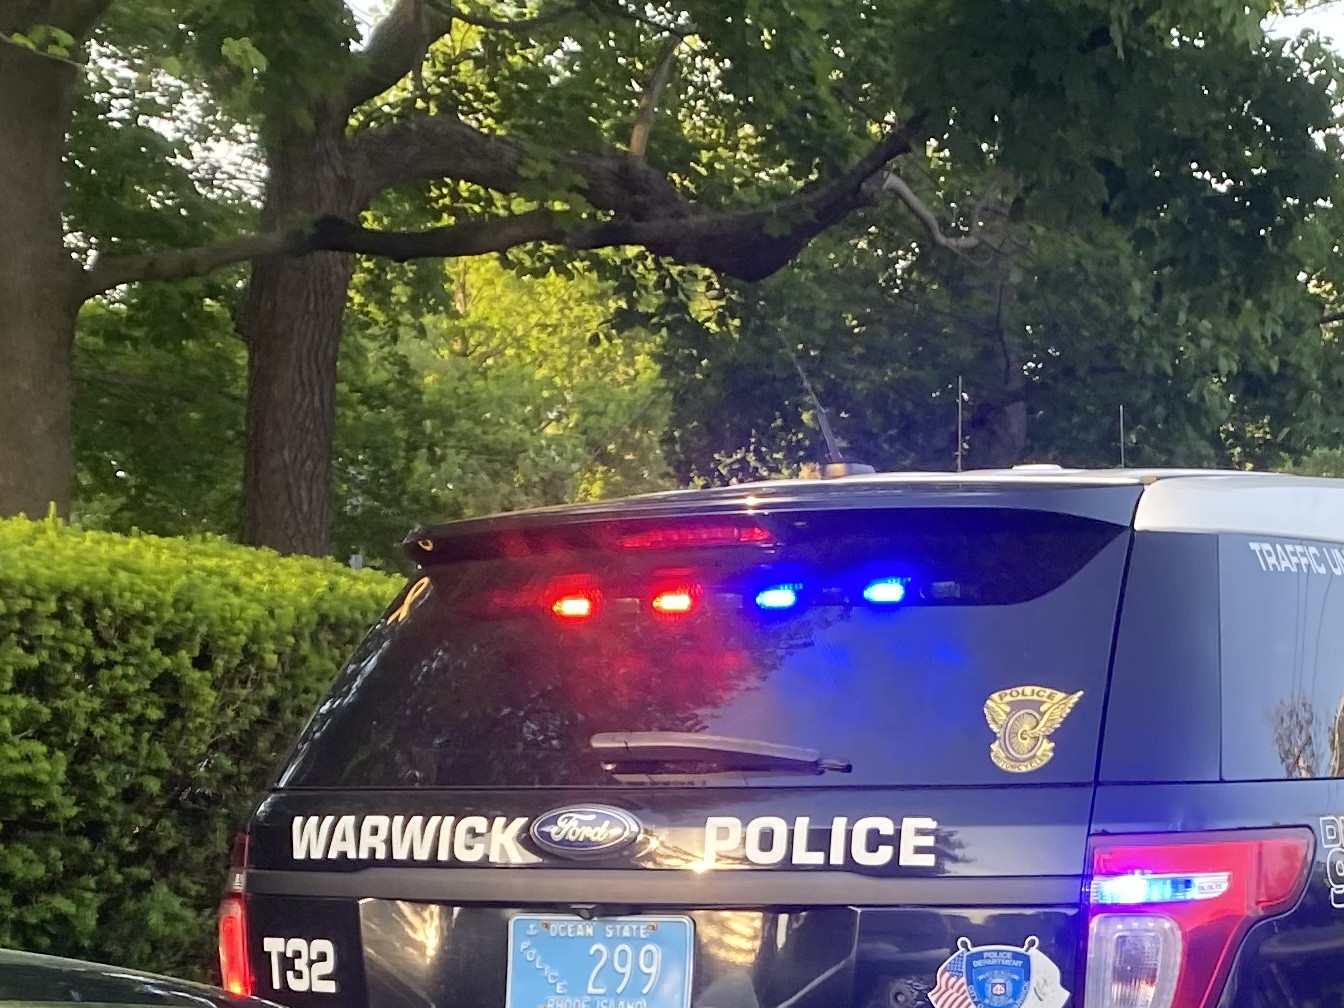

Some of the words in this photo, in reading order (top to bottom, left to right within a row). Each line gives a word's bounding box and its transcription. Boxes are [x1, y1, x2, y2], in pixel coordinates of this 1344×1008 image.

[1249, 542, 1326, 575] TRAFFIC
[998, 689, 1057, 702] POLICE
[291, 815, 530, 863] WARWICK
[550, 812, 610, 842] Ford
[703, 815, 940, 866] POLICE
[550, 922, 594, 937] OCEAN
[605, 923, 651, 939] STATE
[264, 937, 337, 993] T32
[519, 940, 568, 994] POLICE
[586, 943, 662, 995] 299
